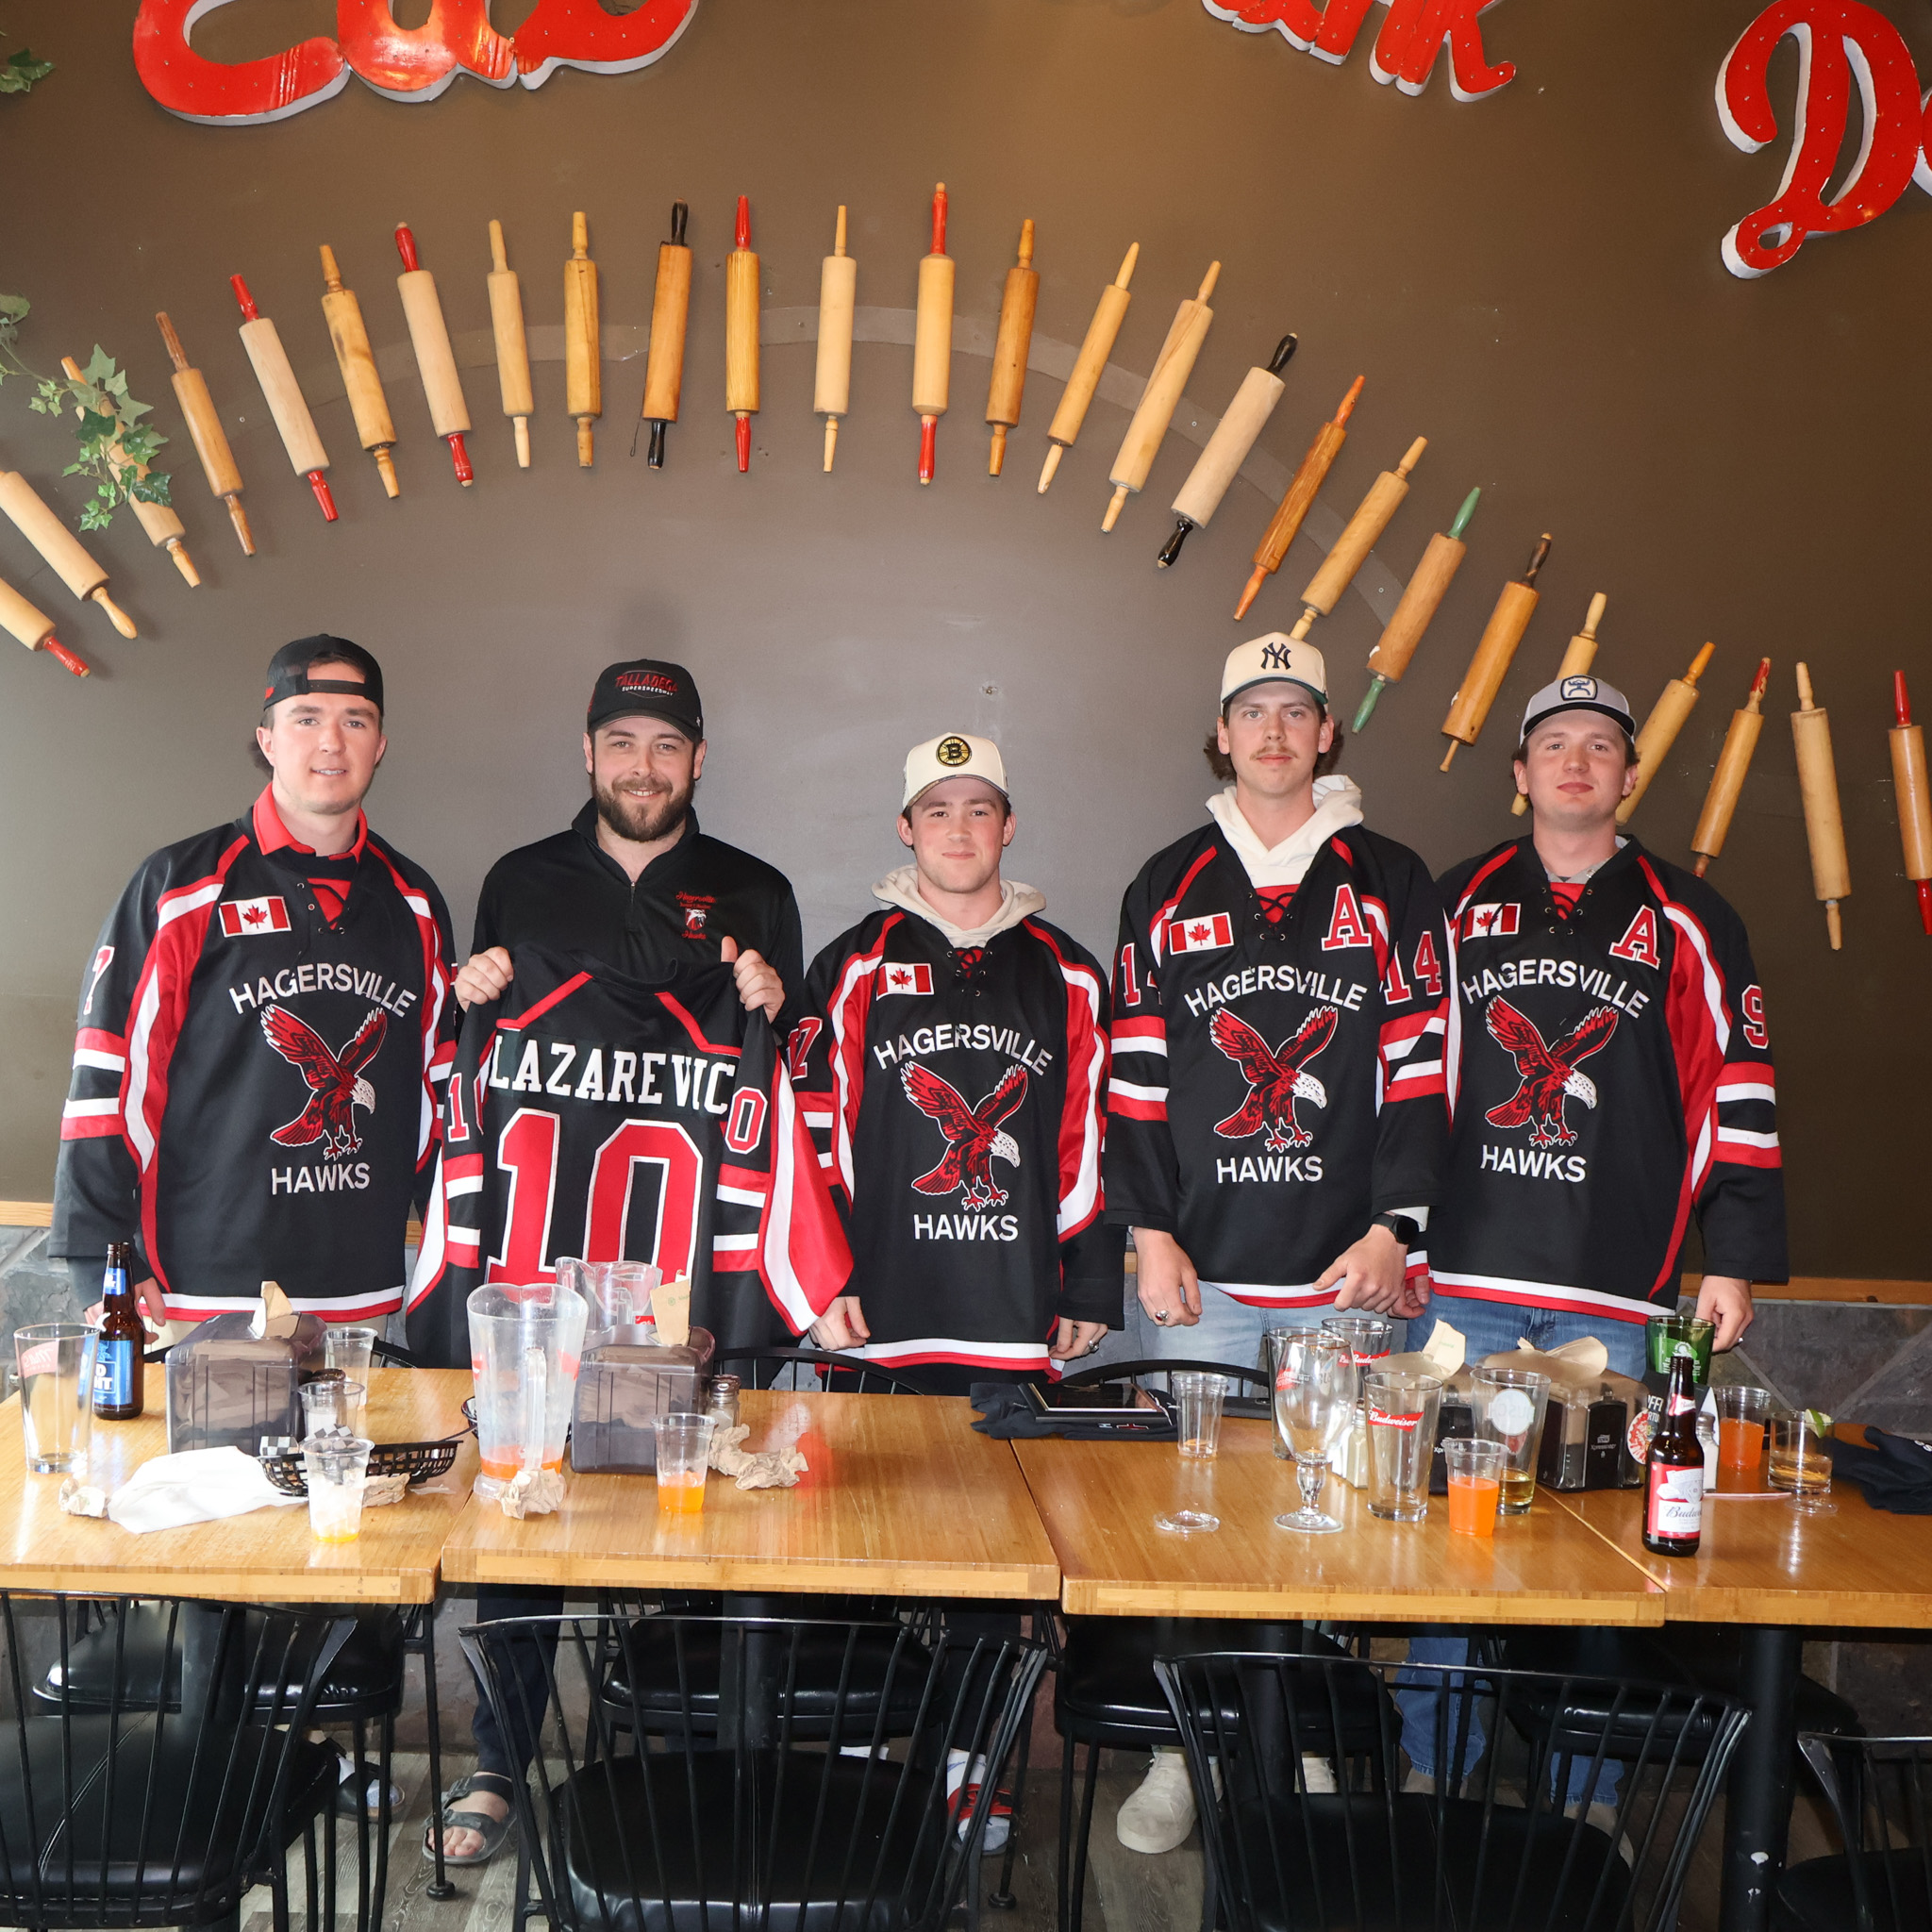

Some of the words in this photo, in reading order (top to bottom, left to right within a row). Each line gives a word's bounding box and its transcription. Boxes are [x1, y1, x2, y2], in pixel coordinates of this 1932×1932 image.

[1322, 883, 1372, 951] A
[1608, 905, 1660, 970] A
[228, 962, 417, 1018] HAGERSVILLE
[1184, 964, 1368, 1018] HAGERSVILLE
[1381, 931, 1443, 1006] 14
[1461, 958, 1650, 1019] HAGERSVILLE
[873, 1023, 1053, 1076] HAGERSVILLE
[271, 1162, 371, 1195] HAWKS
[1216, 1155, 1324, 1184] HAWKS
[1480, 1144, 1587, 1183] HAWKS
[485, 1108, 704, 1309] 10
[913, 1213, 1019, 1241] HAWKS
[1368, 1409, 1418, 1427] Budweiser
